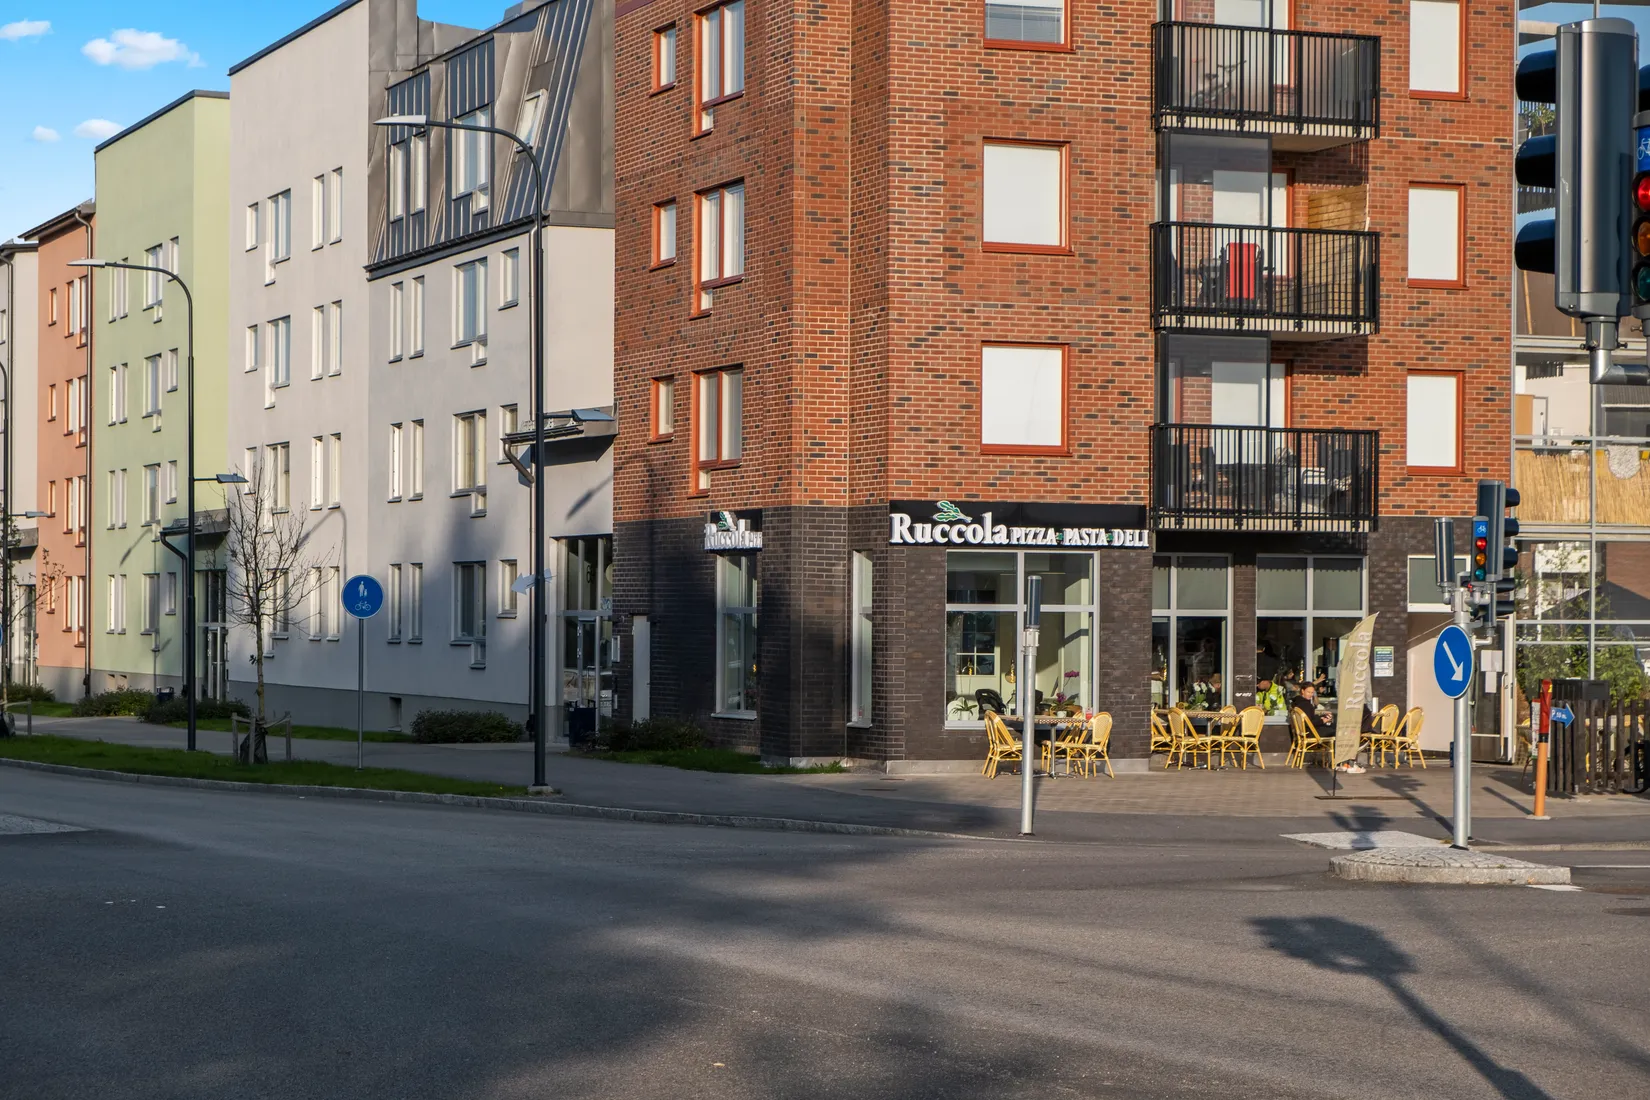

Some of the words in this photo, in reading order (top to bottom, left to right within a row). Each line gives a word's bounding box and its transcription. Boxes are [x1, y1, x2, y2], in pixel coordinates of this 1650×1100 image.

[889, 511, 1009, 545] Ruccola
[1009, 527, 1057, 546] PIZZA
[1062, 528, 1108, 547] PASTA
[1110, 529, 1149, 547] DELI
[1345, 631, 1372, 710] Ruccola
